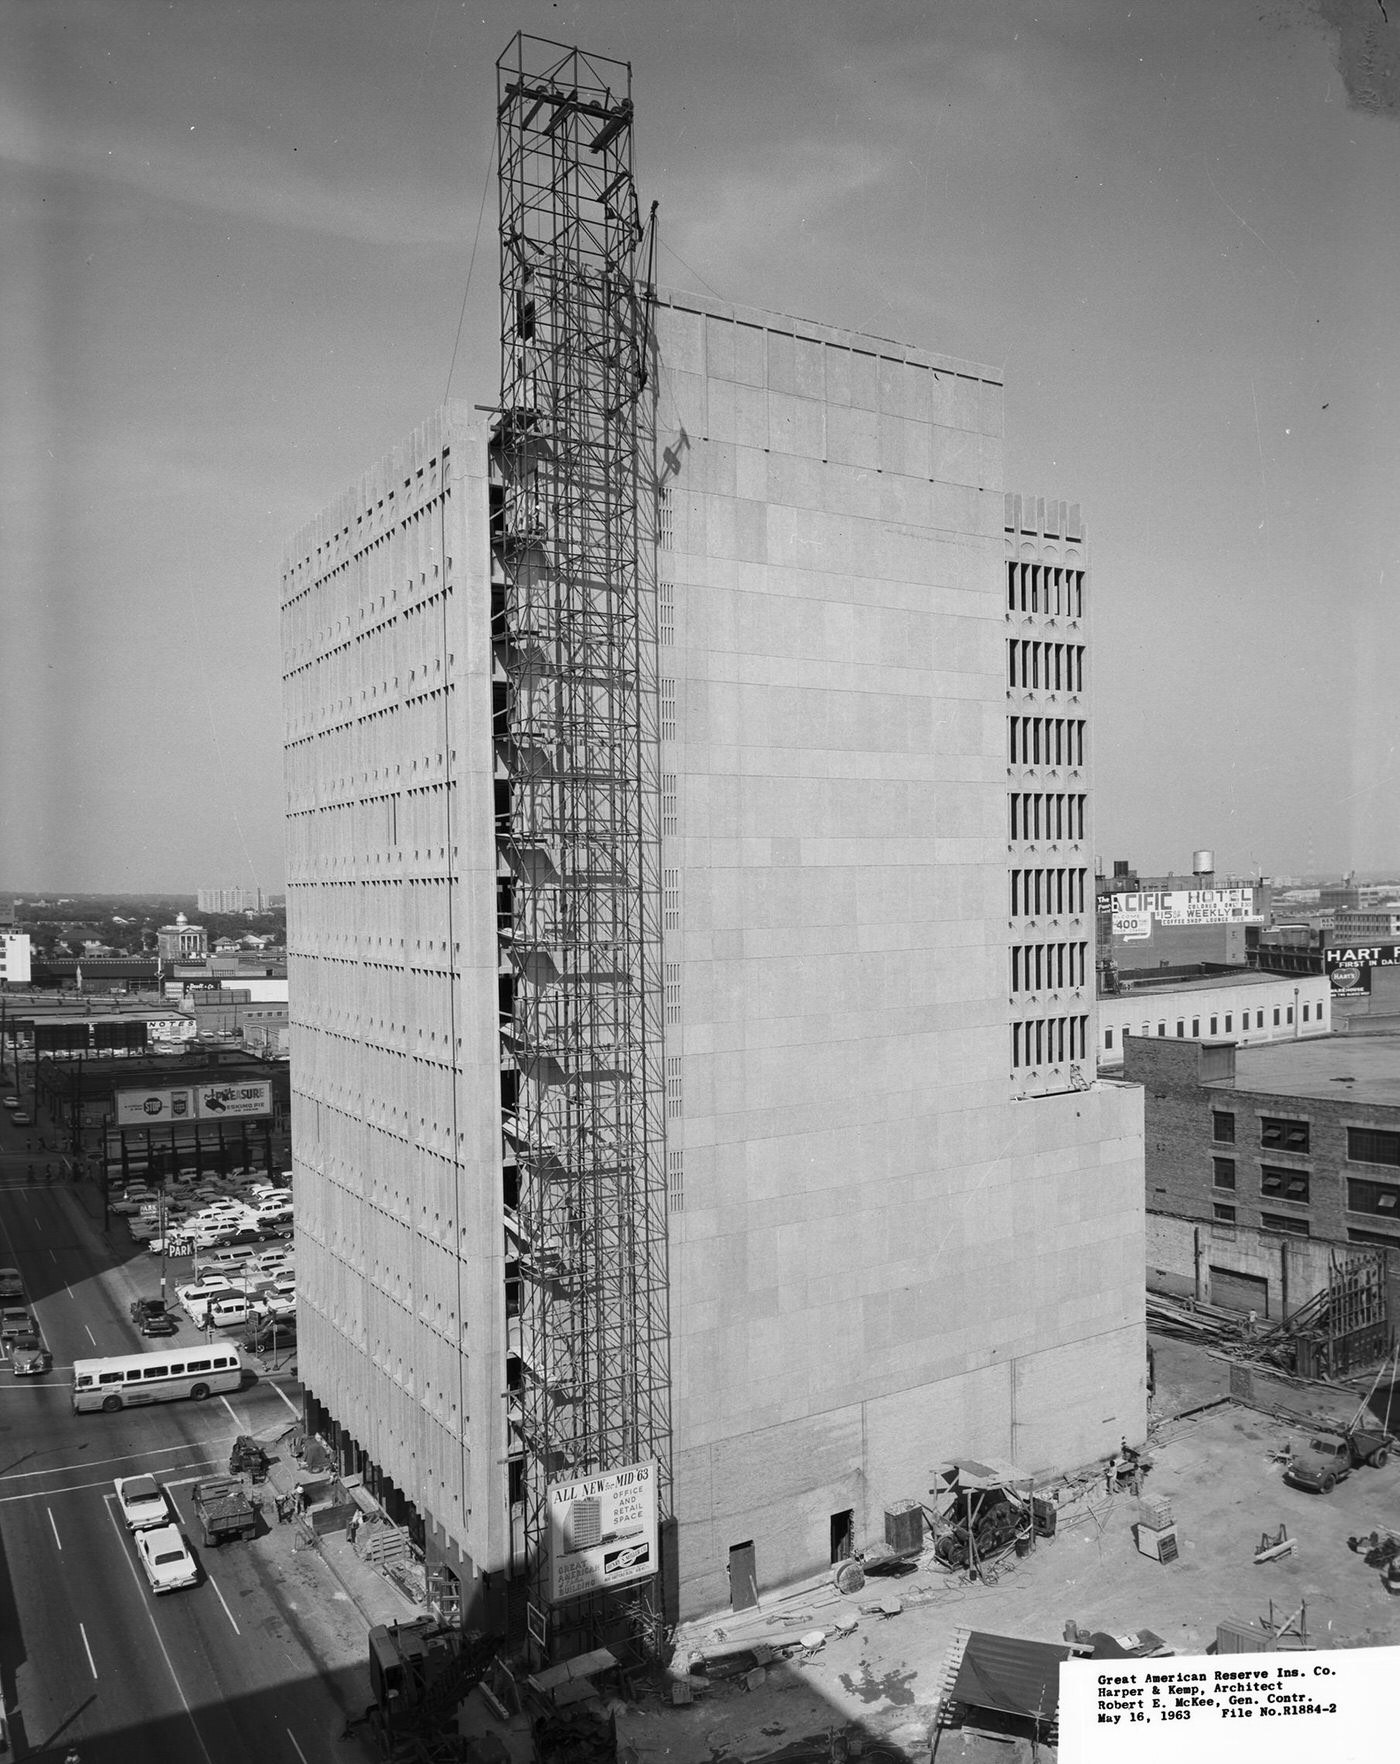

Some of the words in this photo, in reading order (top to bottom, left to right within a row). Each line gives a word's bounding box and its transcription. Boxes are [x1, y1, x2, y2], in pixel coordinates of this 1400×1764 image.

[1188, 889, 1251, 903] HOTEL
[1187, 908, 1230, 917] WEEKLY
[1327, 947, 1382, 962] HART
[145, 1101, 160, 1112] STOP
[169, 1244, 193, 1257] PARK
[553, 1487, 577, 1504] ALL
[582, 1480, 604, 1497] NEW
[616, 1472, 634, 1487] MID
[636, 1468, 649, 1481] '63
[613, 1486, 644, 1499] OFFICE
[619, 1496, 637, 1506] AND
[613, 1503, 644, 1516] RETAIL
[613, 1511, 644, 1525] SPACE
[559, 1560, 587, 1575] GREAT
